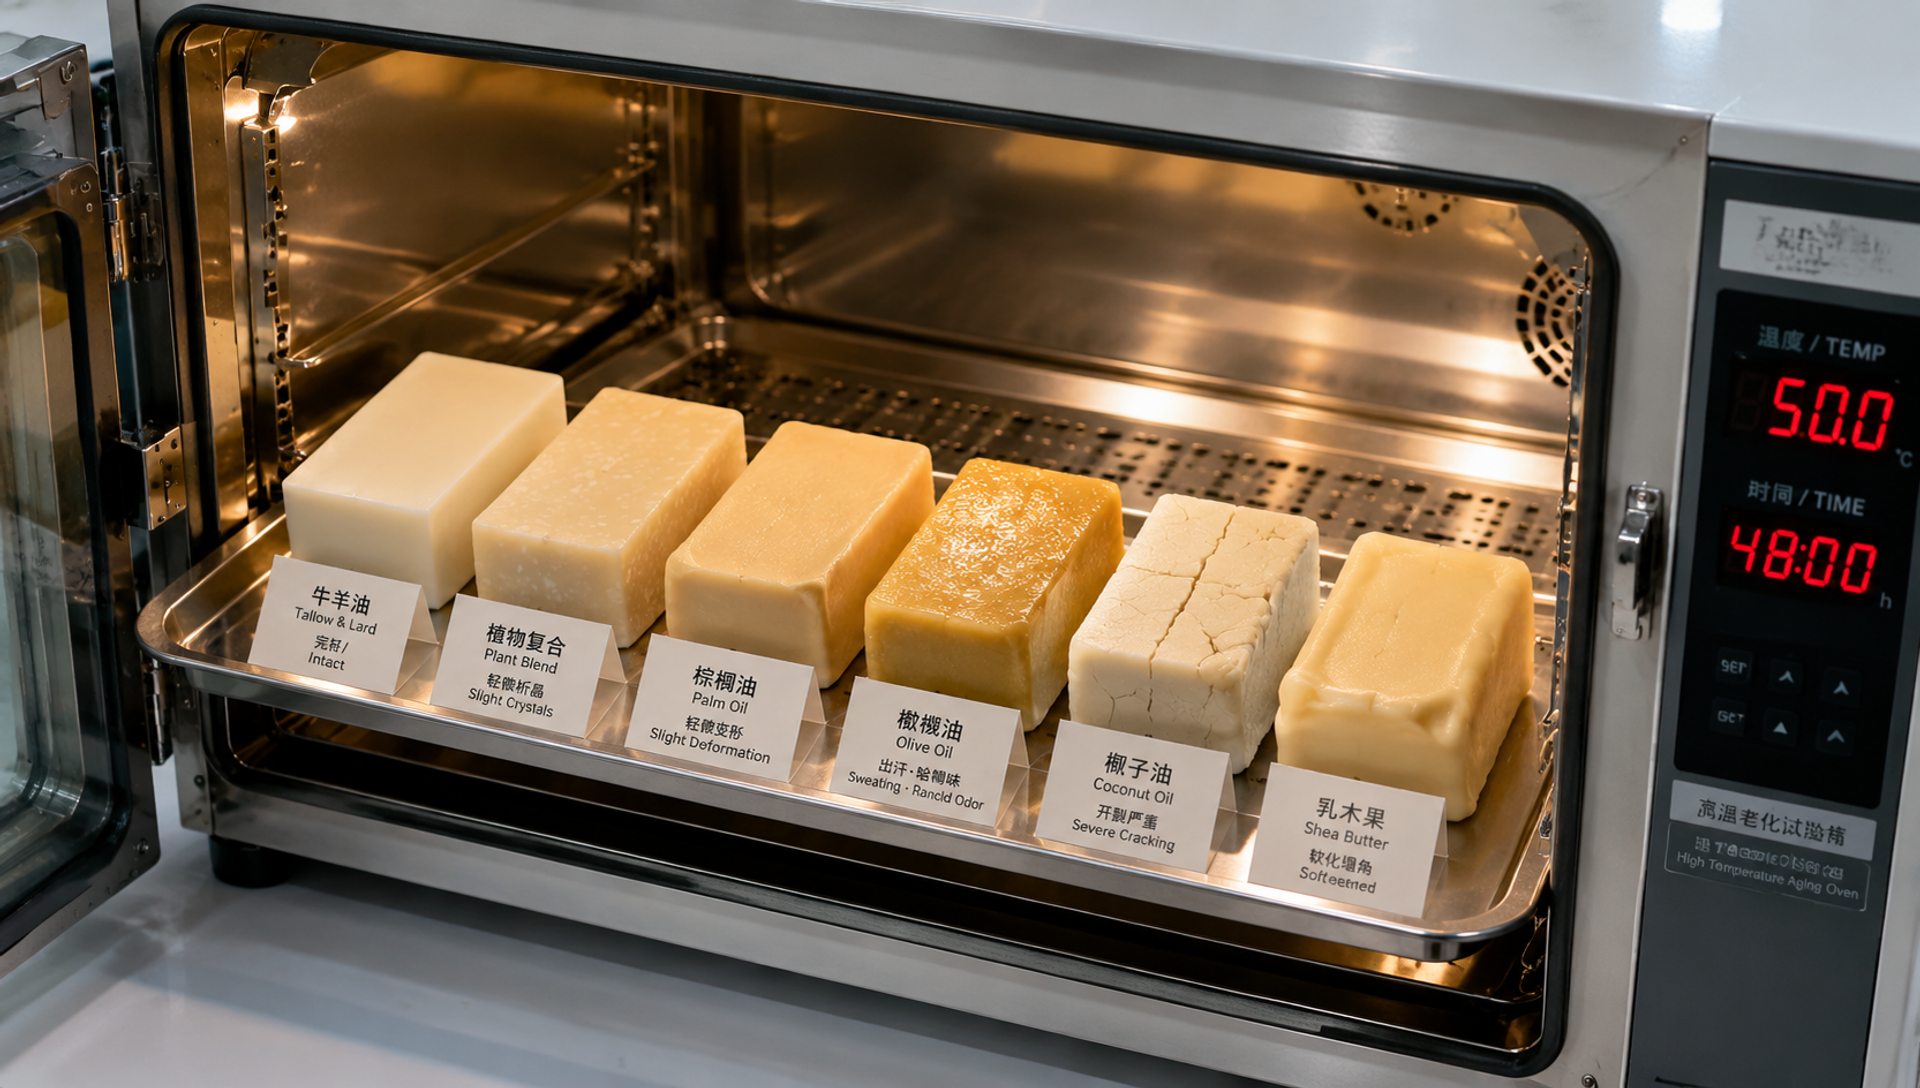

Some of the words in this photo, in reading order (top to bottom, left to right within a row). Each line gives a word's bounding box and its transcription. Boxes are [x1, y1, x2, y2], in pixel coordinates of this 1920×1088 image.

[1826, 336, 1886, 362] TEMP
[1768, 376, 1894, 452] 50.0
[1814, 490, 1866, 516] TIME
[1730, 525, 1877, 594] 48:00
[311, 586, 370, 616] 牛羊油
[1880, 592, 1892, 609] h
[294, 606, 334, 628] Tallow
[336, 615, 346, 628] &
[349, 617, 377, 636] Lard
[308, 652, 345, 671] Intact
[484, 648, 517, 667] Plant
[520, 656, 558, 675] Blend
[468, 687, 502, 707] Slight
[506, 695, 554, 718] Crystals
[692, 691, 724, 712] Palm
[727, 698, 748, 715] Oil
[650, 726, 686, 748] Slight
[689, 735, 771, 764] Deformation
[896, 736, 930, 755] Olive
[934, 744, 954, 759] Oil
[848, 771, 901, 795] Sweating
[955, 794, 984, 812] Odor
[1093, 777, 1150, 801] Coconut
[1154, 790, 1174, 806] Oil
[1072, 818, 1116, 838] Severe
[1120, 828, 1176, 854] Cracking
[1304, 820, 1339, 841] Shea
[1344, 830, 1388, 851] Butter
[1677, 851, 1705, 869] High
[1708, 858, 1784, 885] Temperature
[1788, 875, 1822, 894] Aging
[1826, 882, 1859, 900] Oven
